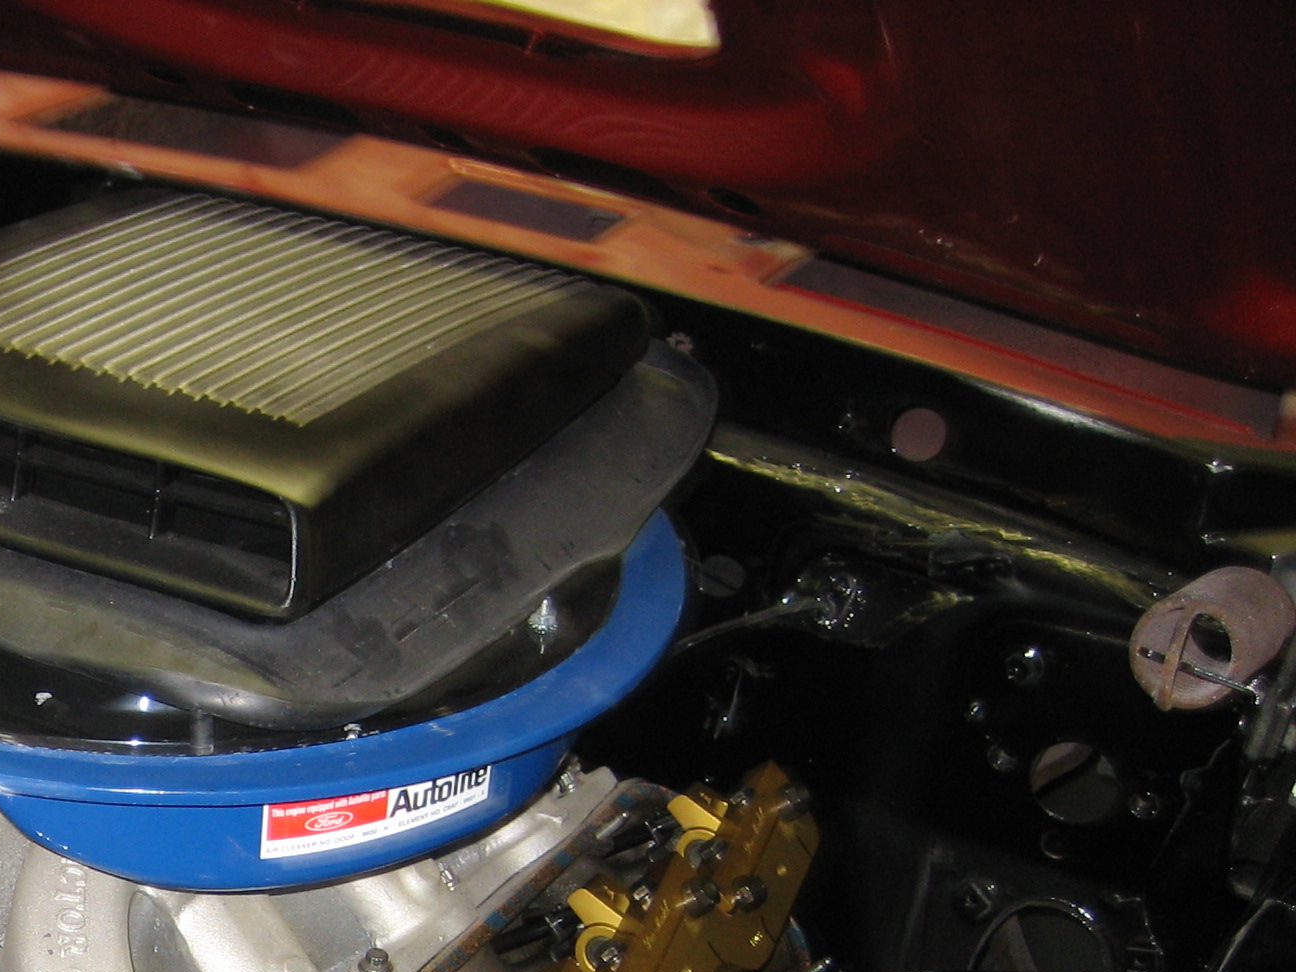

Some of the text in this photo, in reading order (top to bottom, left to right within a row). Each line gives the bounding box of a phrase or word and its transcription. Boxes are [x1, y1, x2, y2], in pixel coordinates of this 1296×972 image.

[389, 765, 488, 818] Autolite
[272, 808, 285, 818] This
[285, 806, 306, 817] engine
[306, 800, 334, 814] equipped
[335, 798, 348, 808] with
[314, 814, 345, 829] Ford
[398, 813, 429, 828] ELEMENT
[281, 840, 317, 851] CLEANER
[54, 857, 89, 959] CTOR
